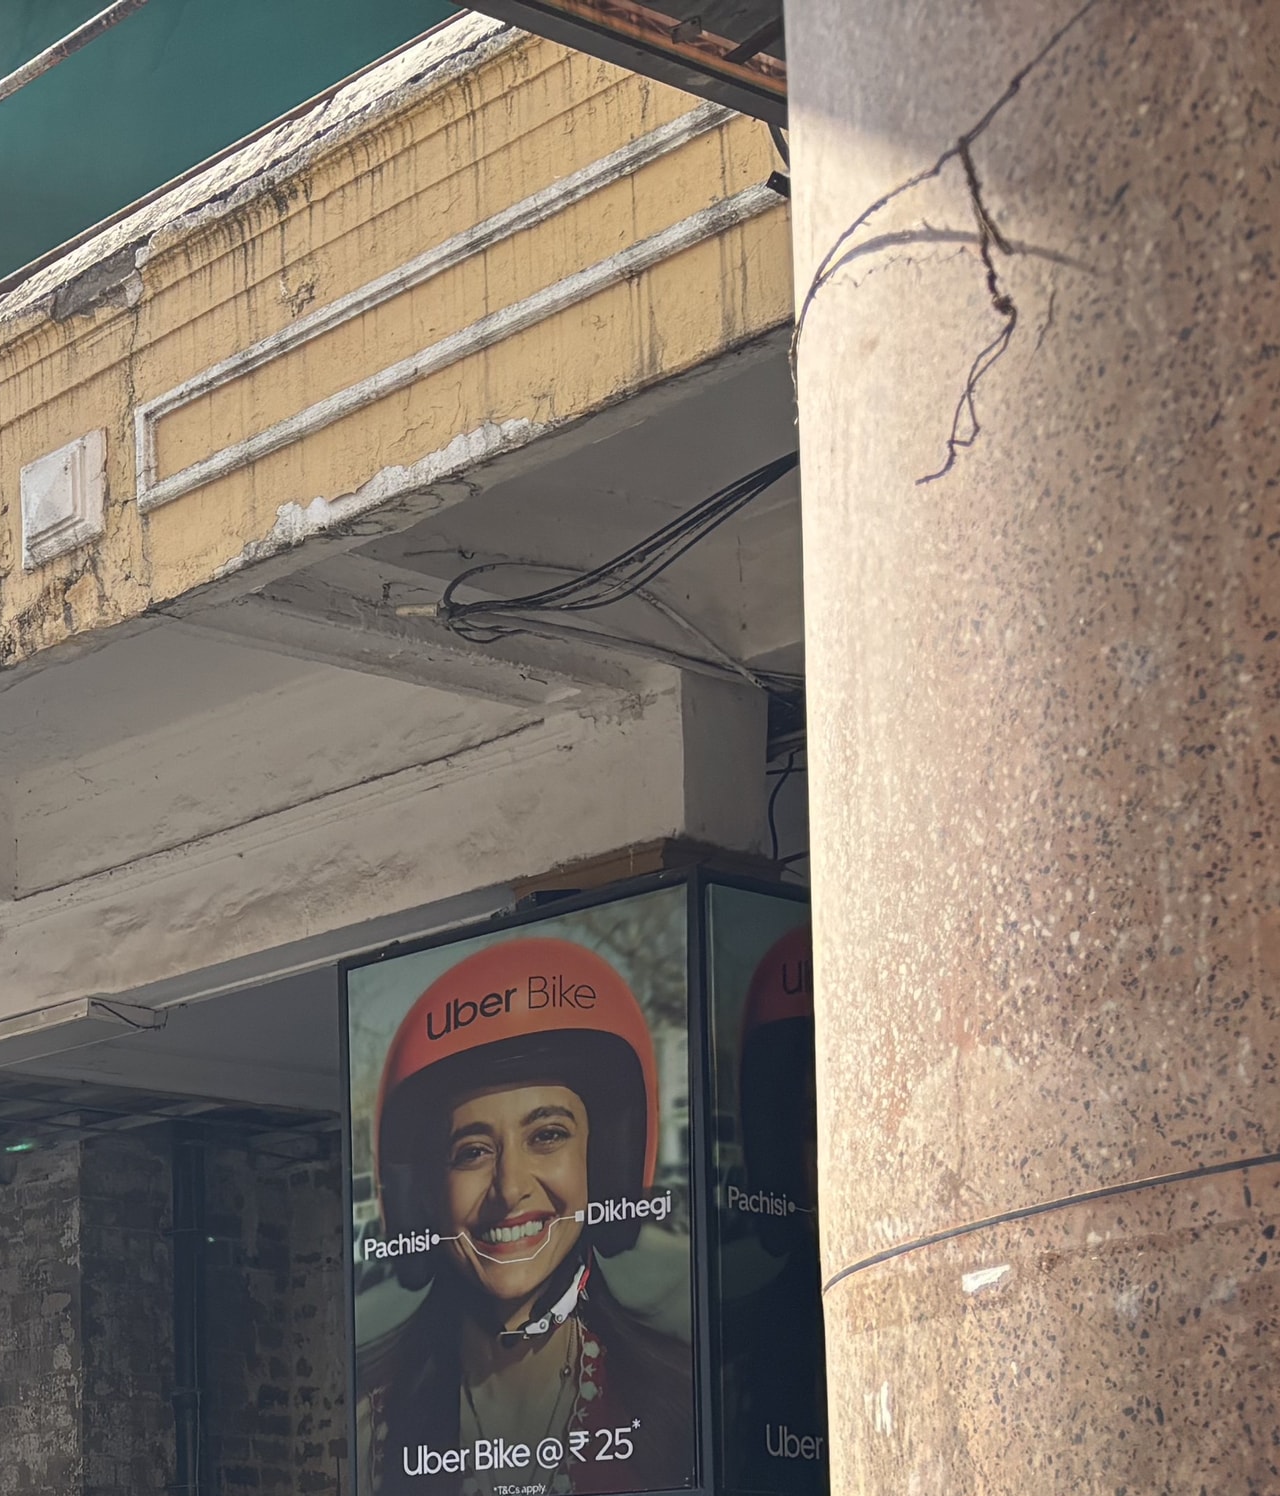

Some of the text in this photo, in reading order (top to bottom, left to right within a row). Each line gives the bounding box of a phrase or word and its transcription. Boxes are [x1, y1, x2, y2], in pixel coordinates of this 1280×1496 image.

[426, 975, 596, 1041] Uber Bike
[587, 1191, 671, 1225] Dikhegi
[727, 1185, 787, 1216] Pachisi
[364, 1230, 431, 1261] Pachisi
[403, 1445, 469, 1476] Uber
[475, 1438, 531, 1470] Bike
[536, 1437, 564, 1469] @
[765, 1424, 824, 1459] Uber
[521, 1484, 546, 1495] apply
